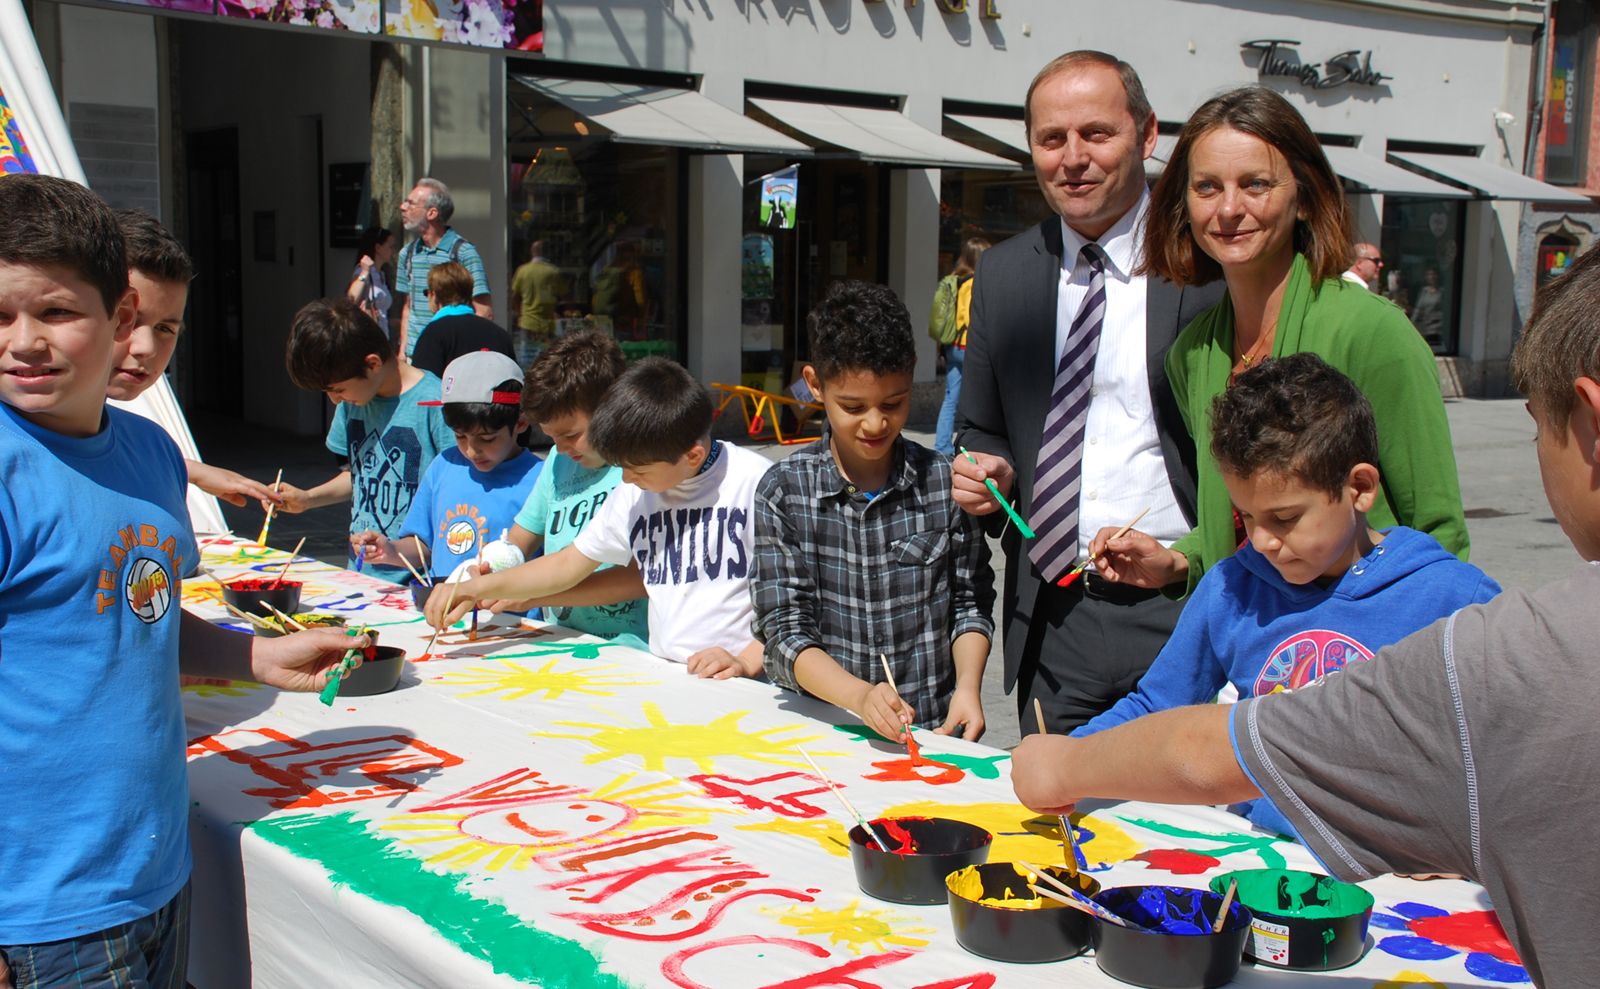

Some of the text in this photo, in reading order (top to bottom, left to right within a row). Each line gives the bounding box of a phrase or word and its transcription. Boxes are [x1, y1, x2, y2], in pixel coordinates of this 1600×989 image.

[550, 486, 616, 538] UGB
[629, 506, 747, 586] GENIUS
[97, 523, 183, 614] TEAMBALL
